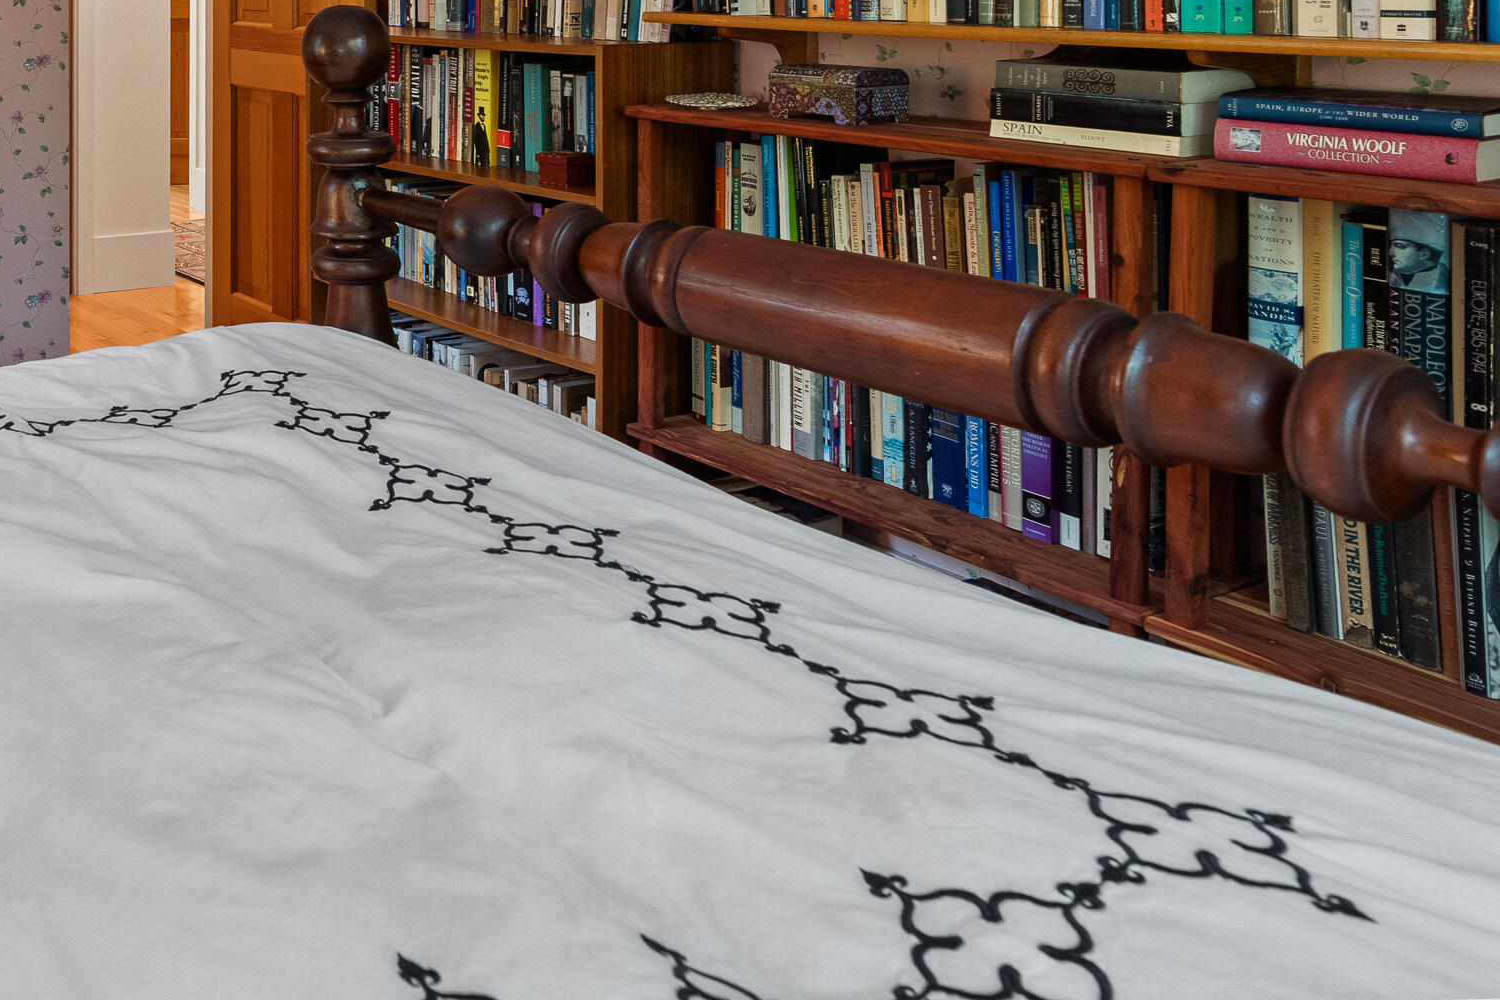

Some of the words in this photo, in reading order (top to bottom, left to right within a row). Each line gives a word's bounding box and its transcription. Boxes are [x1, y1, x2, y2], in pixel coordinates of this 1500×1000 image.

[1165, 109, 1174, 129] YALE
[1256, 103, 1285, 112] SPAIN,
[1287, 106, 1323, 114] EUROPE
[1346, 110, 1379, 118] WIDER
[1381, 113, 1419, 121] WORLD
[1002, 121, 1043, 136] SPAIN
[1080, 134, 1106, 142] ELLIOTT
[1286, 131, 1348, 151] VIRGINIA
[1351, 137, 1408, 156] WOOLF
[1307, 149, 1380, 164] COLLECTION
[1249, 212, 1294, 224] WEALTH
[969, 222, 978, 250] Shoots
[1312, 250, 1321, 266] THE
[1311, 267, 1321, 301] THEATER
[1388, 289, 1399, 330] ALAN
[1311, 315, 1320, 344] NATURE
[1404, 291, 1422, 361] BONAPA
[793, 386, 804, 428] MILLION
[1470, 402, 1487, 413] 8
[969, 420, 980, 467] ROMANS
[1010, 430, 1021, 463] WORLD
[970, 469, 980, 489] DID
[990, 453, 1000, 490] EMPIRE
[1010, 472, 1020, 488] OF
[1065, 466, 1074, 494] LEGACY
[1268, 502, 1281, 546] DARKNESS
[1343, 529, 1359, 546] IN
[1462, 506, 1473, 552] NAIPAUL
[1345, 546, 1362, 576] THE
[1348, 575, 1365, 617] RIVER
[1464, 573, 1477, 616] BEYOND
[1467, 619, 1478, 657] BELIEF
